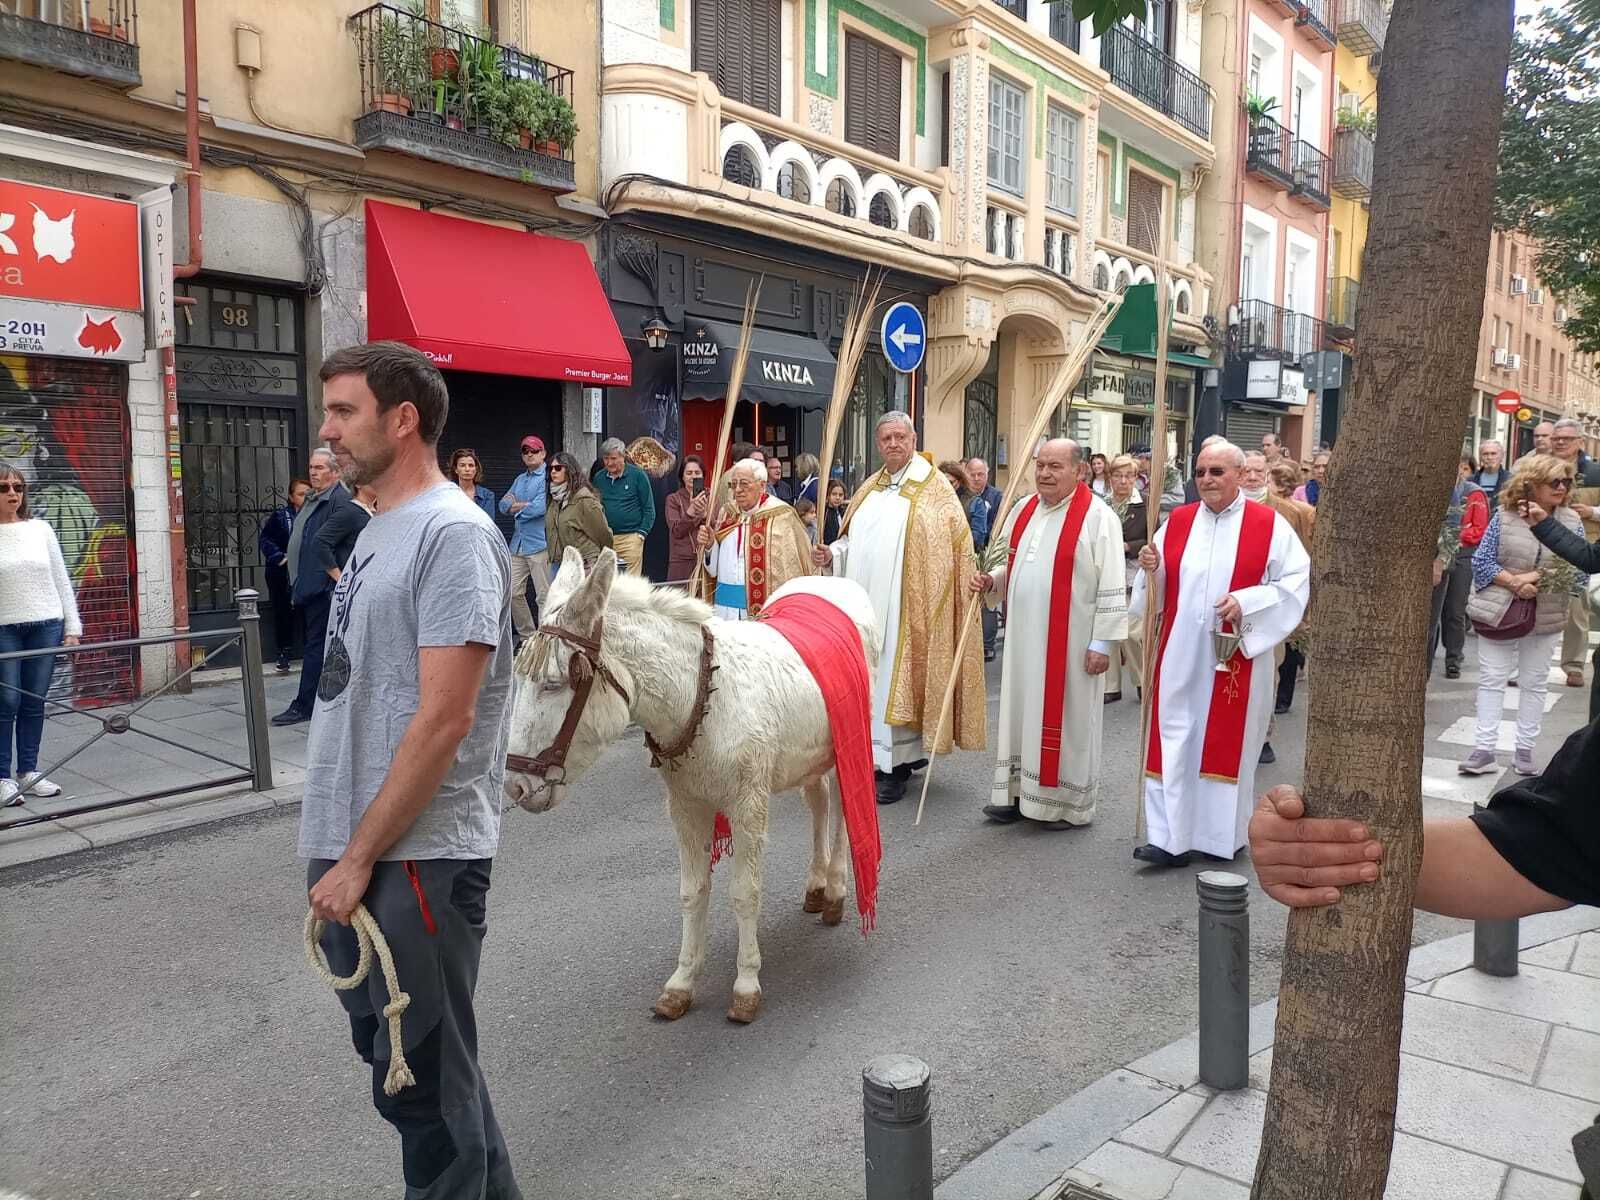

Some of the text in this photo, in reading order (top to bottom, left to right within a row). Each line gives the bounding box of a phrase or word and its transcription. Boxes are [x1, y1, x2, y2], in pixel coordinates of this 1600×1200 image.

[222, 307, 249, 327] 98
[13, 343, 44, 352] PREVIA
[683, 343, 719, 356] KINZA
[565, 368, 629, 382] Premier Burger Joint
[762, 361, 815, 386] KINZA
[1103, 374, 1153, 398] FARMACI
